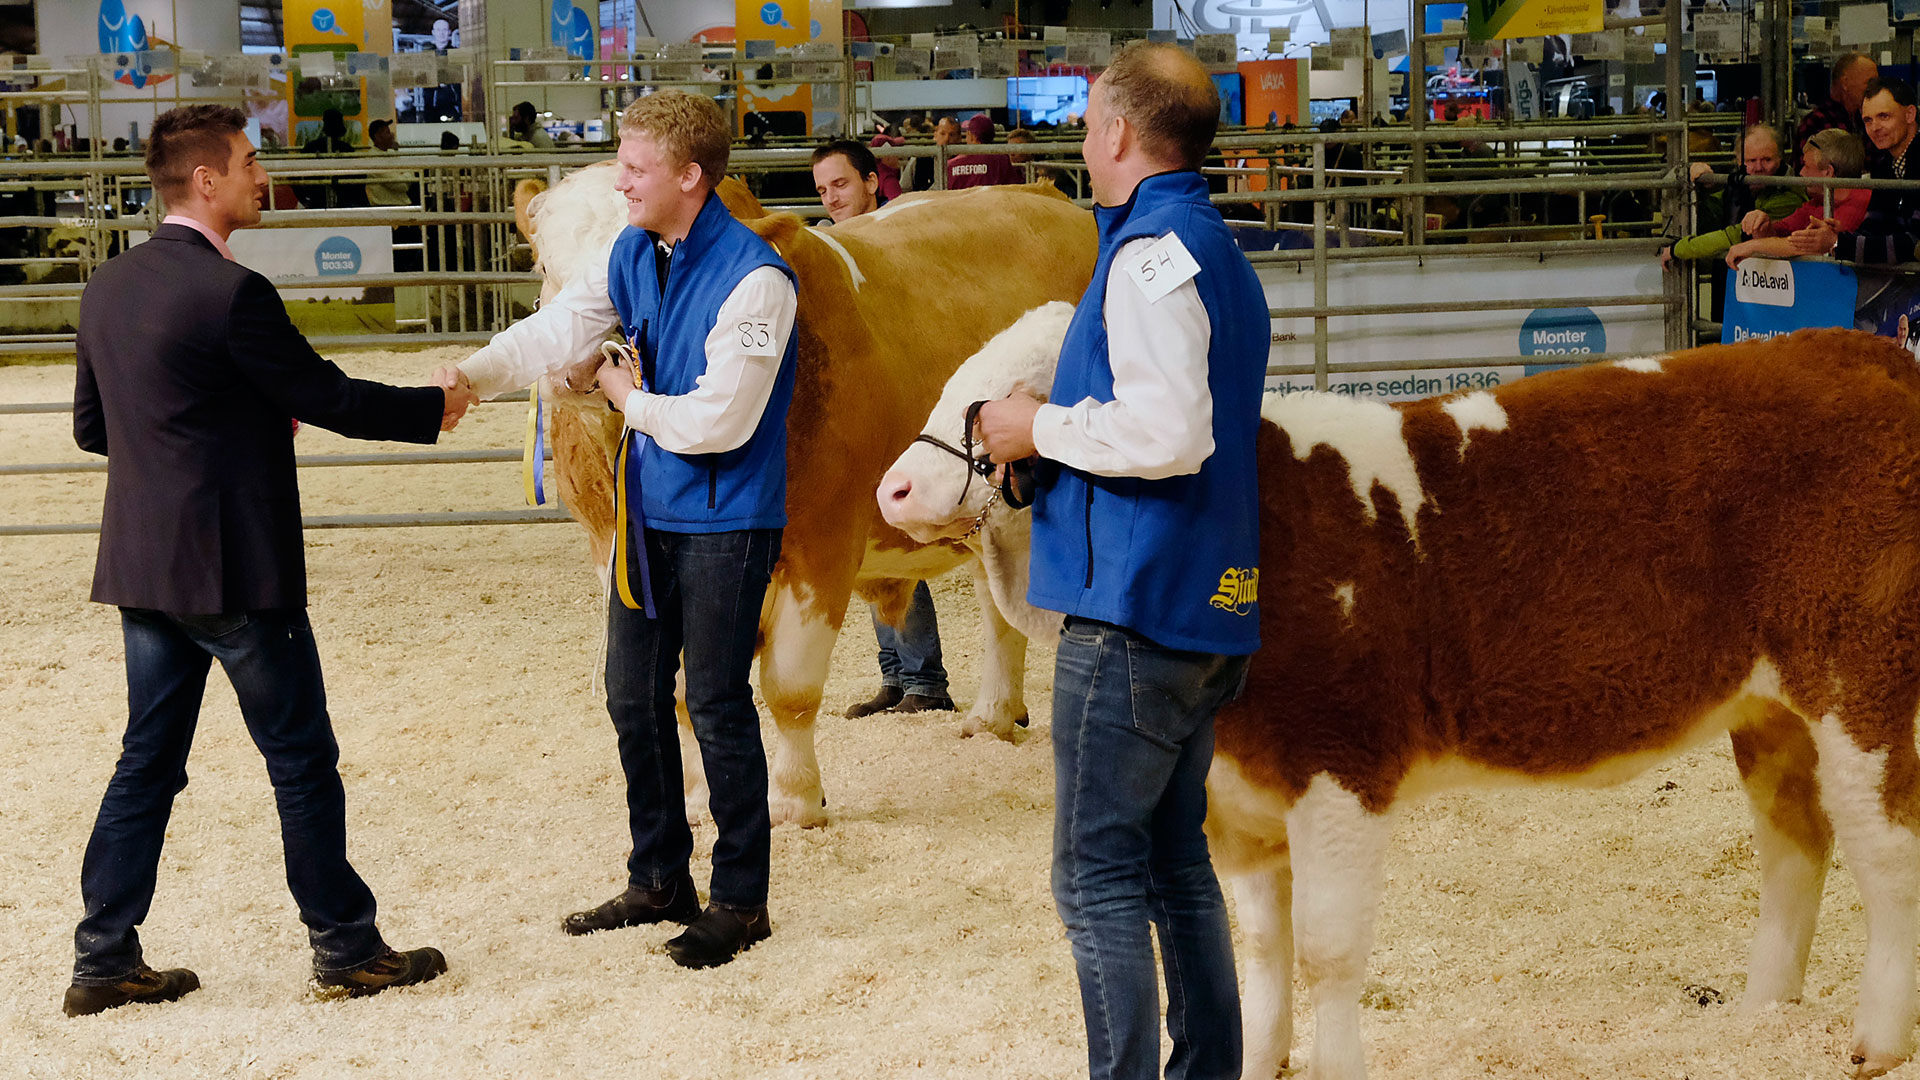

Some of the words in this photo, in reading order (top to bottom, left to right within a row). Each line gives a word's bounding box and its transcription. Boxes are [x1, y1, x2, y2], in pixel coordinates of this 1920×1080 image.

[952, 164, 988, 177] HEREFORD
[321, 251, 351, 261] Monter
[1141, 250, 1175, 282] 54
[1752, 270, 1789, 291] DeLaval
[738, 321, 769, 348] 83
[1272, 332, 1297, 343] Bank
[1532, 329, 1587, 345] Monter
[1376, 374, 1442, 397] sedan
[1446, 371, 1502, 392] 1836
